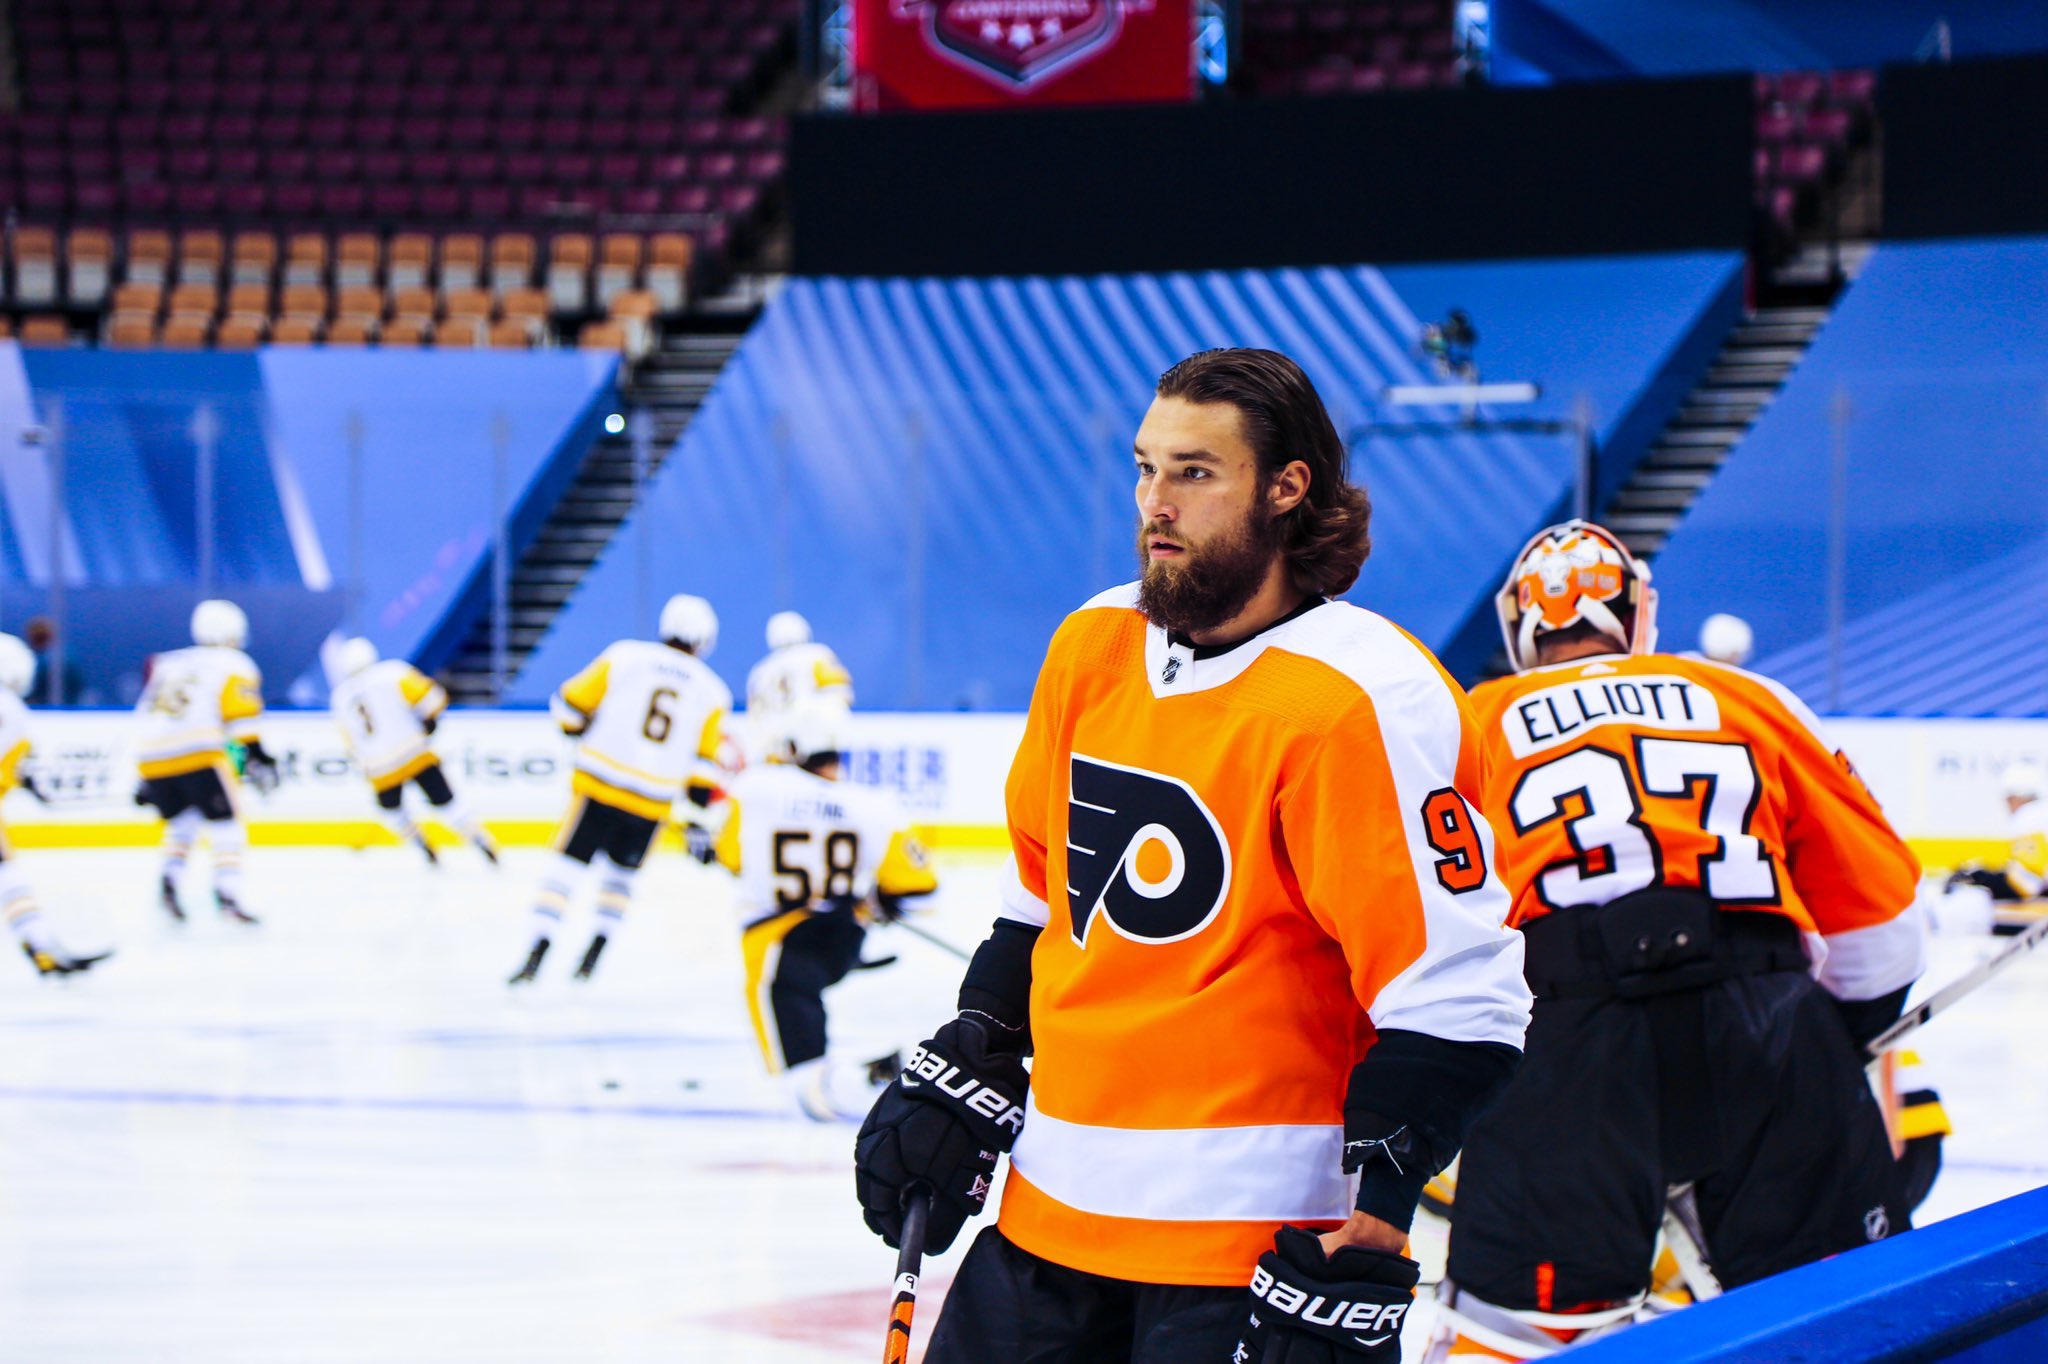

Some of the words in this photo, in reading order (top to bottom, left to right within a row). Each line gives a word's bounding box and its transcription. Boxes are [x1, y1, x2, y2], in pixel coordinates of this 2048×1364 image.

[642, 686, 679, 745] 6
[1518, 683, 1694, 743] ELLIOTT
[1420, 786, 1488, 896] 9
[1507, 732, 1782, 909] 37
[773, 831, 859, 907] 58
[905, 1046, 1026, 1135] BAUER
[1250, 1264, 1409, 1331] BAUER
